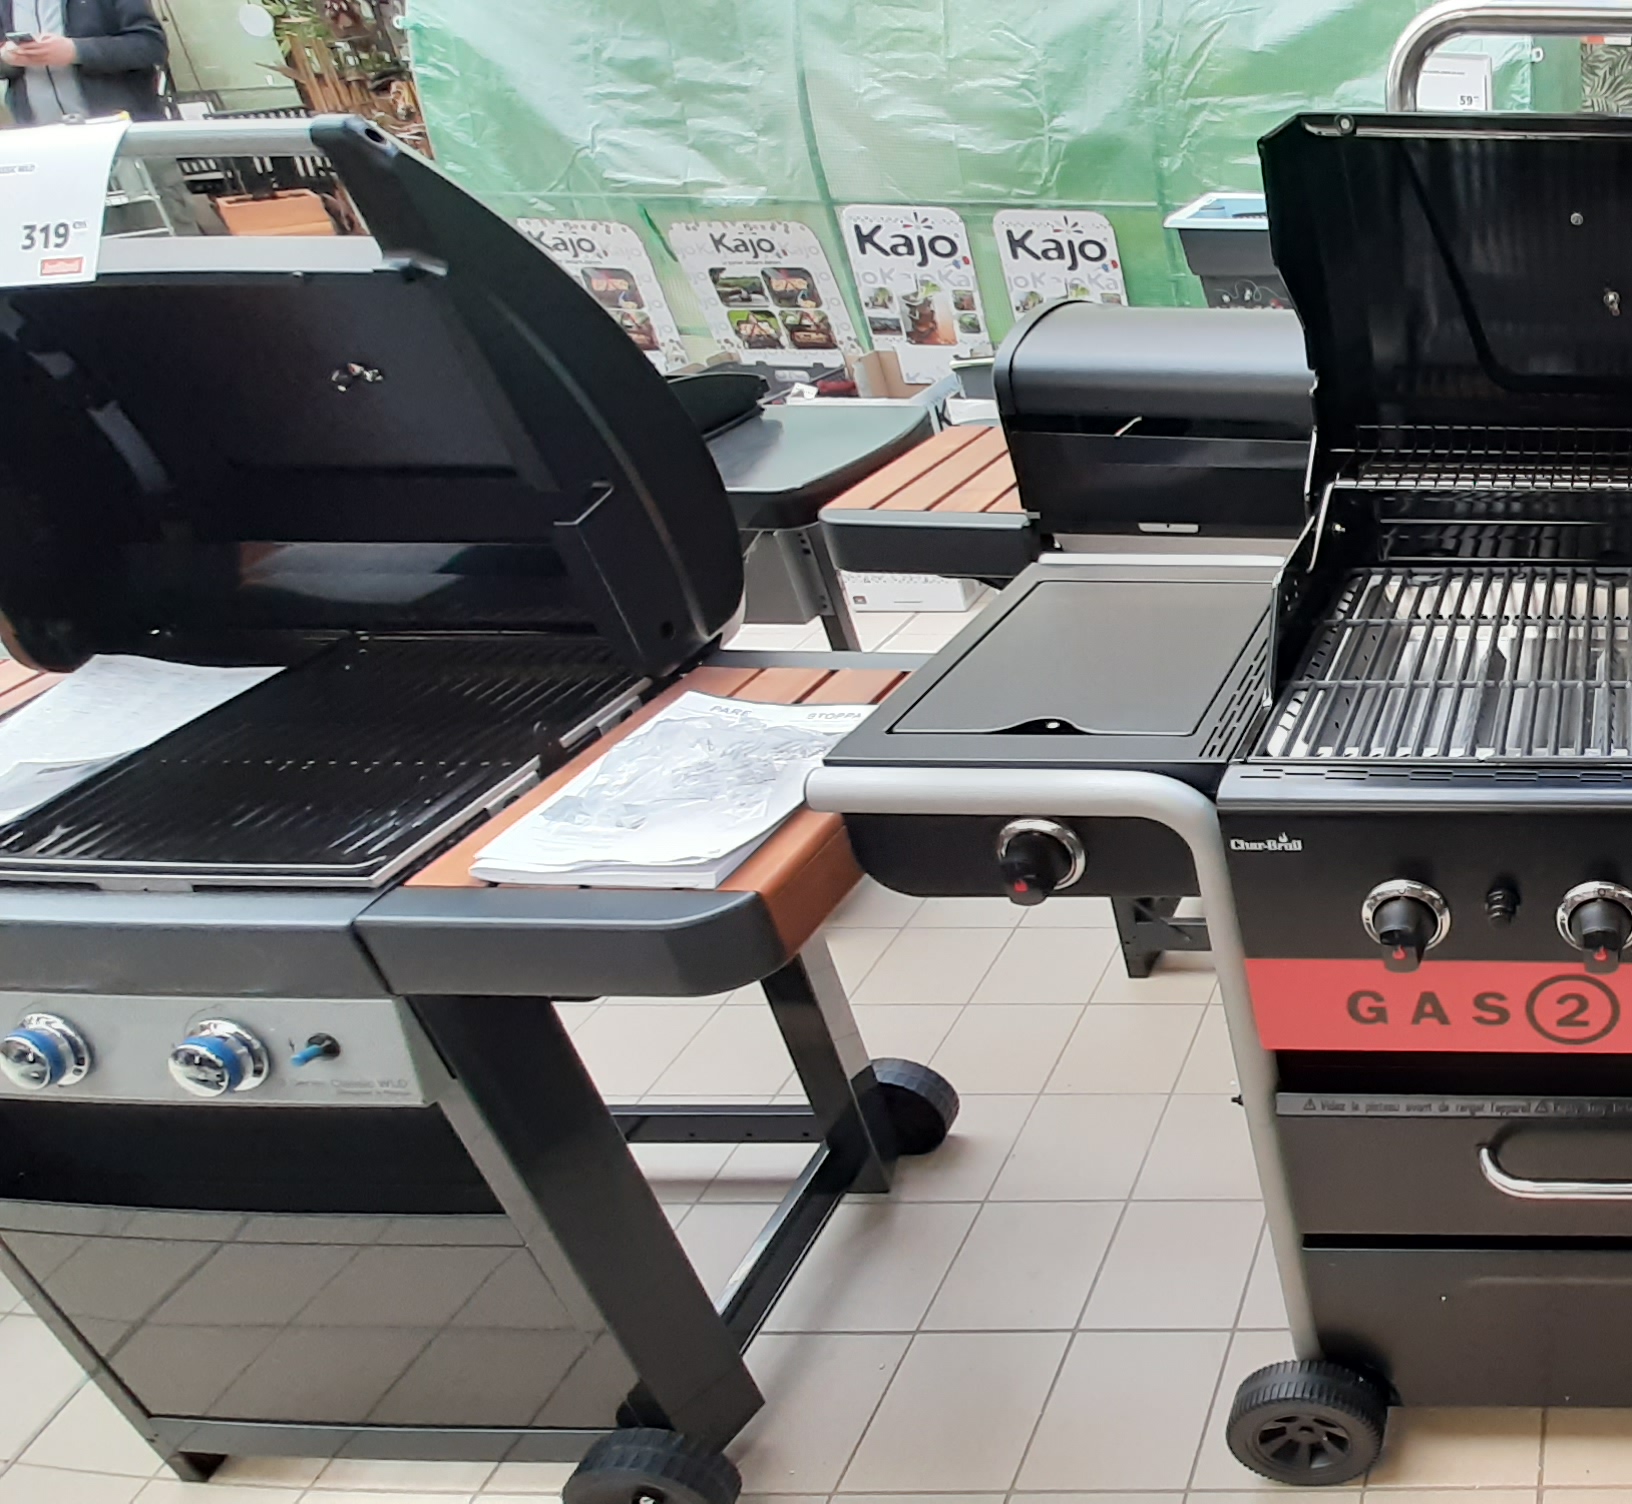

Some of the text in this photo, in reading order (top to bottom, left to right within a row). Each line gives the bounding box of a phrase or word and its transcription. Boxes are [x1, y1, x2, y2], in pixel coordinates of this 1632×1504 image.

[20, 222, 70, 250] 319
[708, 231, 776, 259] Kajo
[853, 222, 959, 268] Kajo
[1005, 227, 1108, 271] Kajo
[1229, 838, 1303, 852] Char-Broil
[1346, 988, 1513, 1027] GAS
